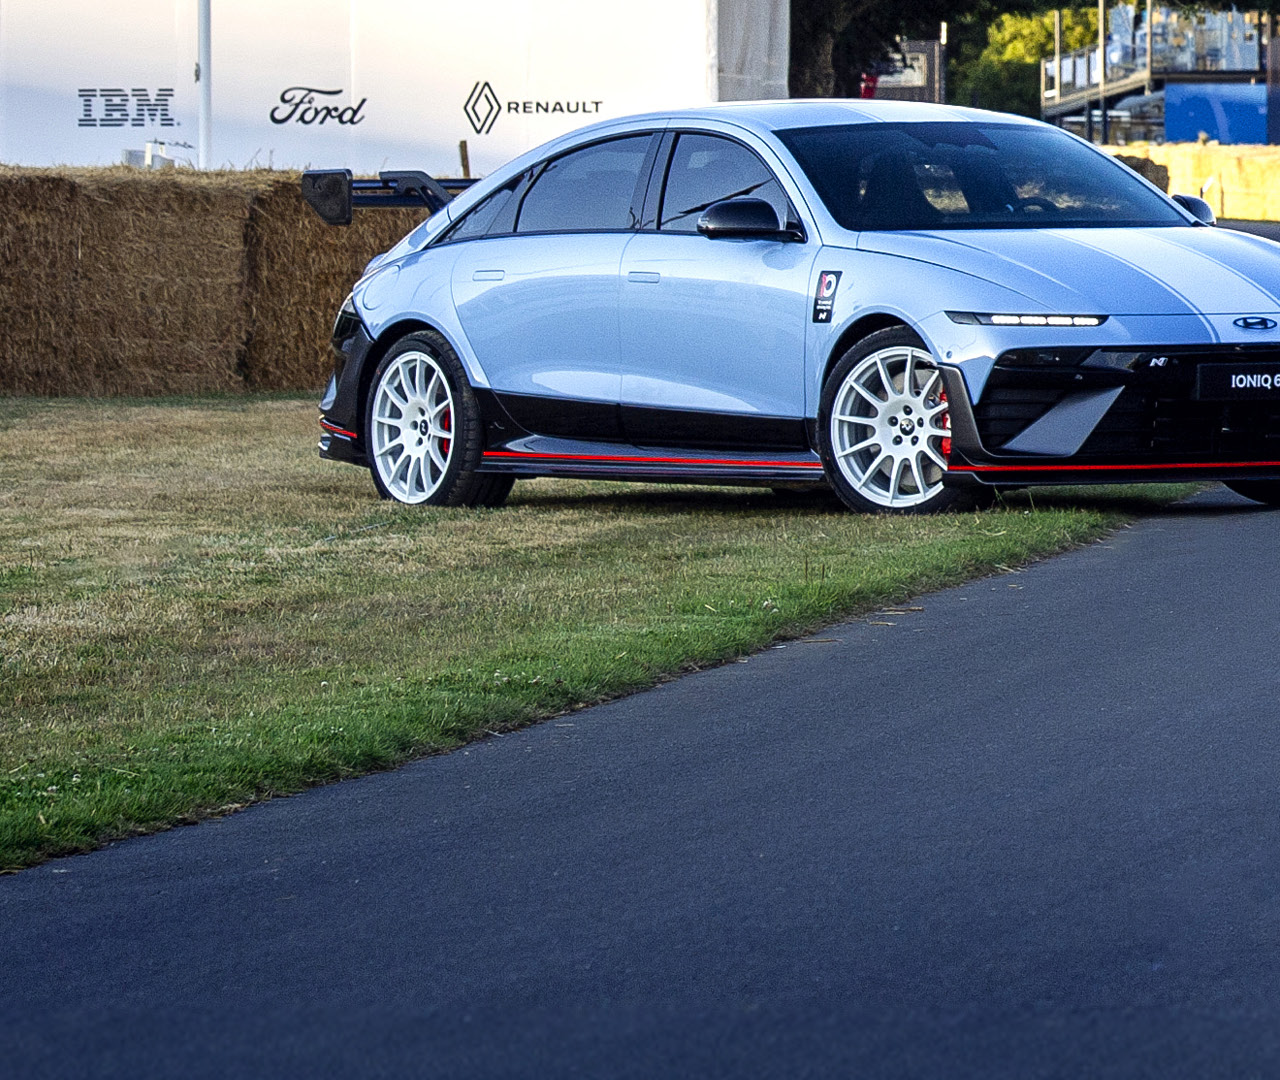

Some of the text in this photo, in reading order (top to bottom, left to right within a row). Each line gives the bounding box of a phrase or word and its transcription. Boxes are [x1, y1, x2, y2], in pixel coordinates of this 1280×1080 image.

[77, 88, 175, 127] IBM
[269, 85, 368, 126] Ford
[506, 100, 604, 115] RENAULT
[1230, 373, 1272, 390] IONIQ
